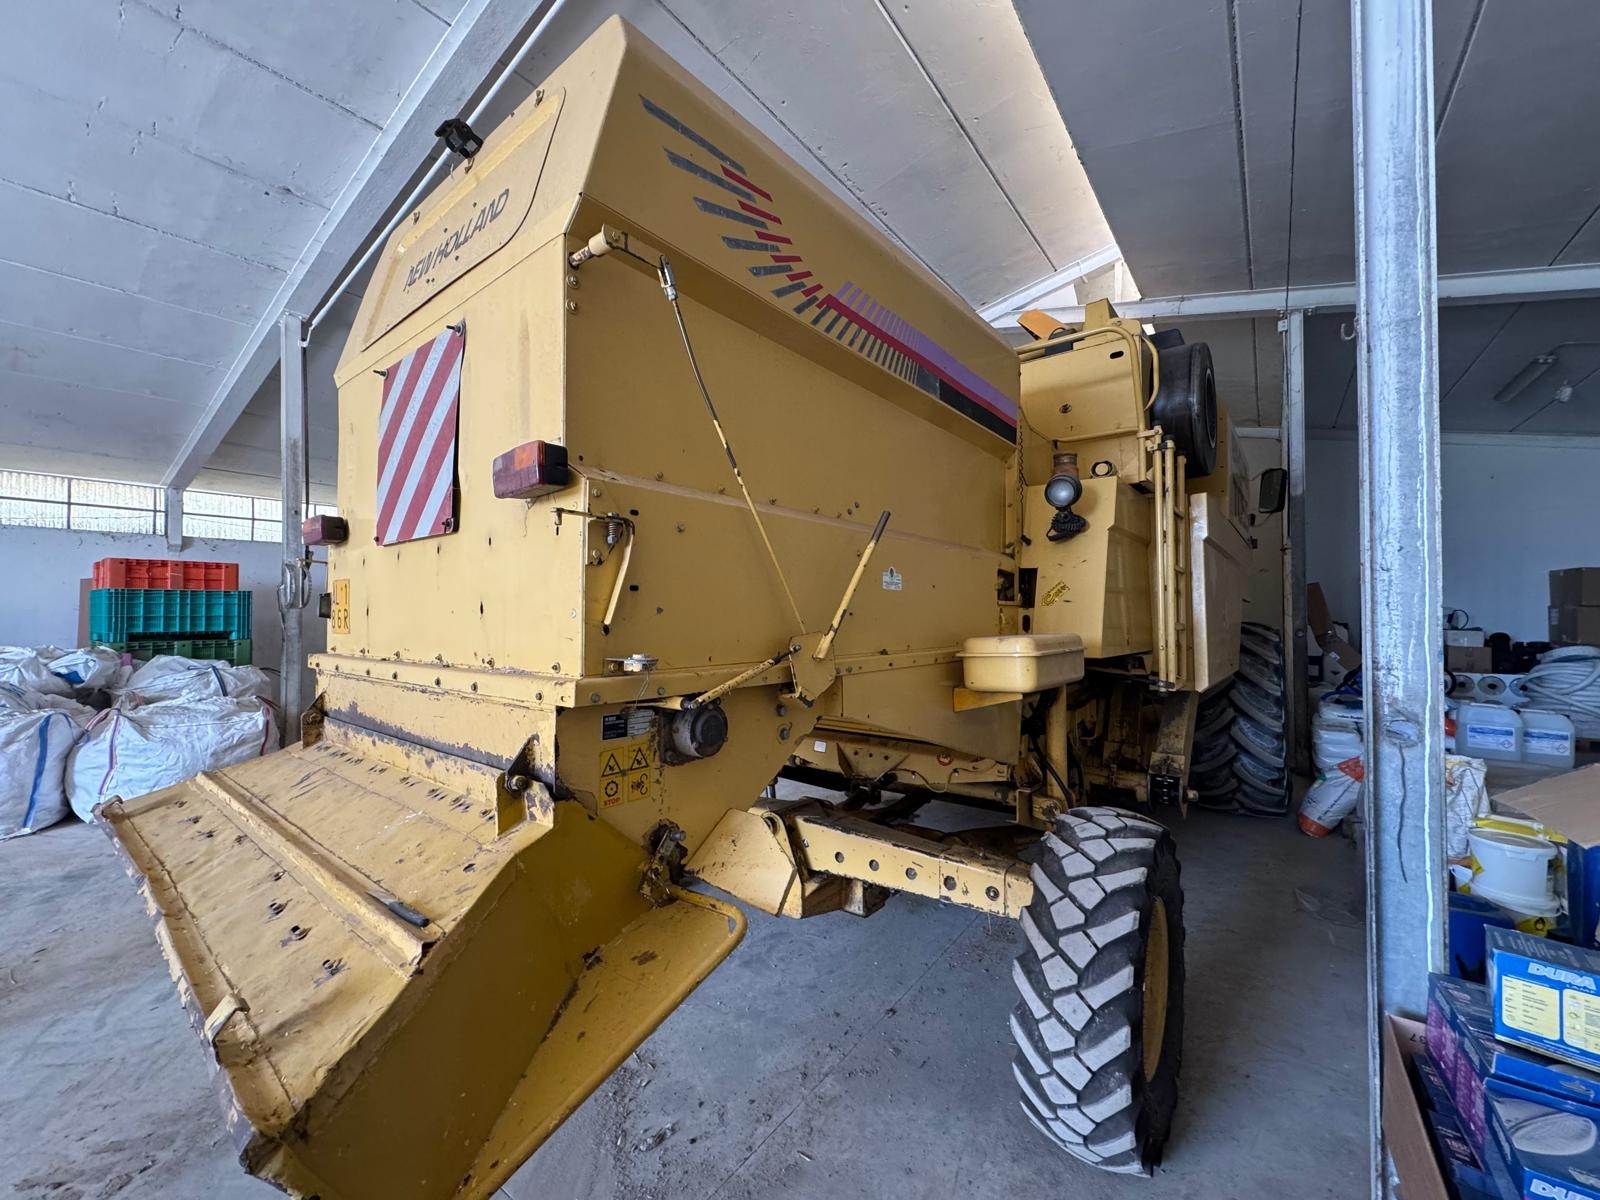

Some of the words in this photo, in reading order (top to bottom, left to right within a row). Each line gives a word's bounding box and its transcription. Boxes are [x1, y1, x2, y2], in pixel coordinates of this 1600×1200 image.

[403, 251, 433, 293] NEW
[432, 188, 510, 269] HOLLAND
[1527, 962, 1597, 991] DURA
